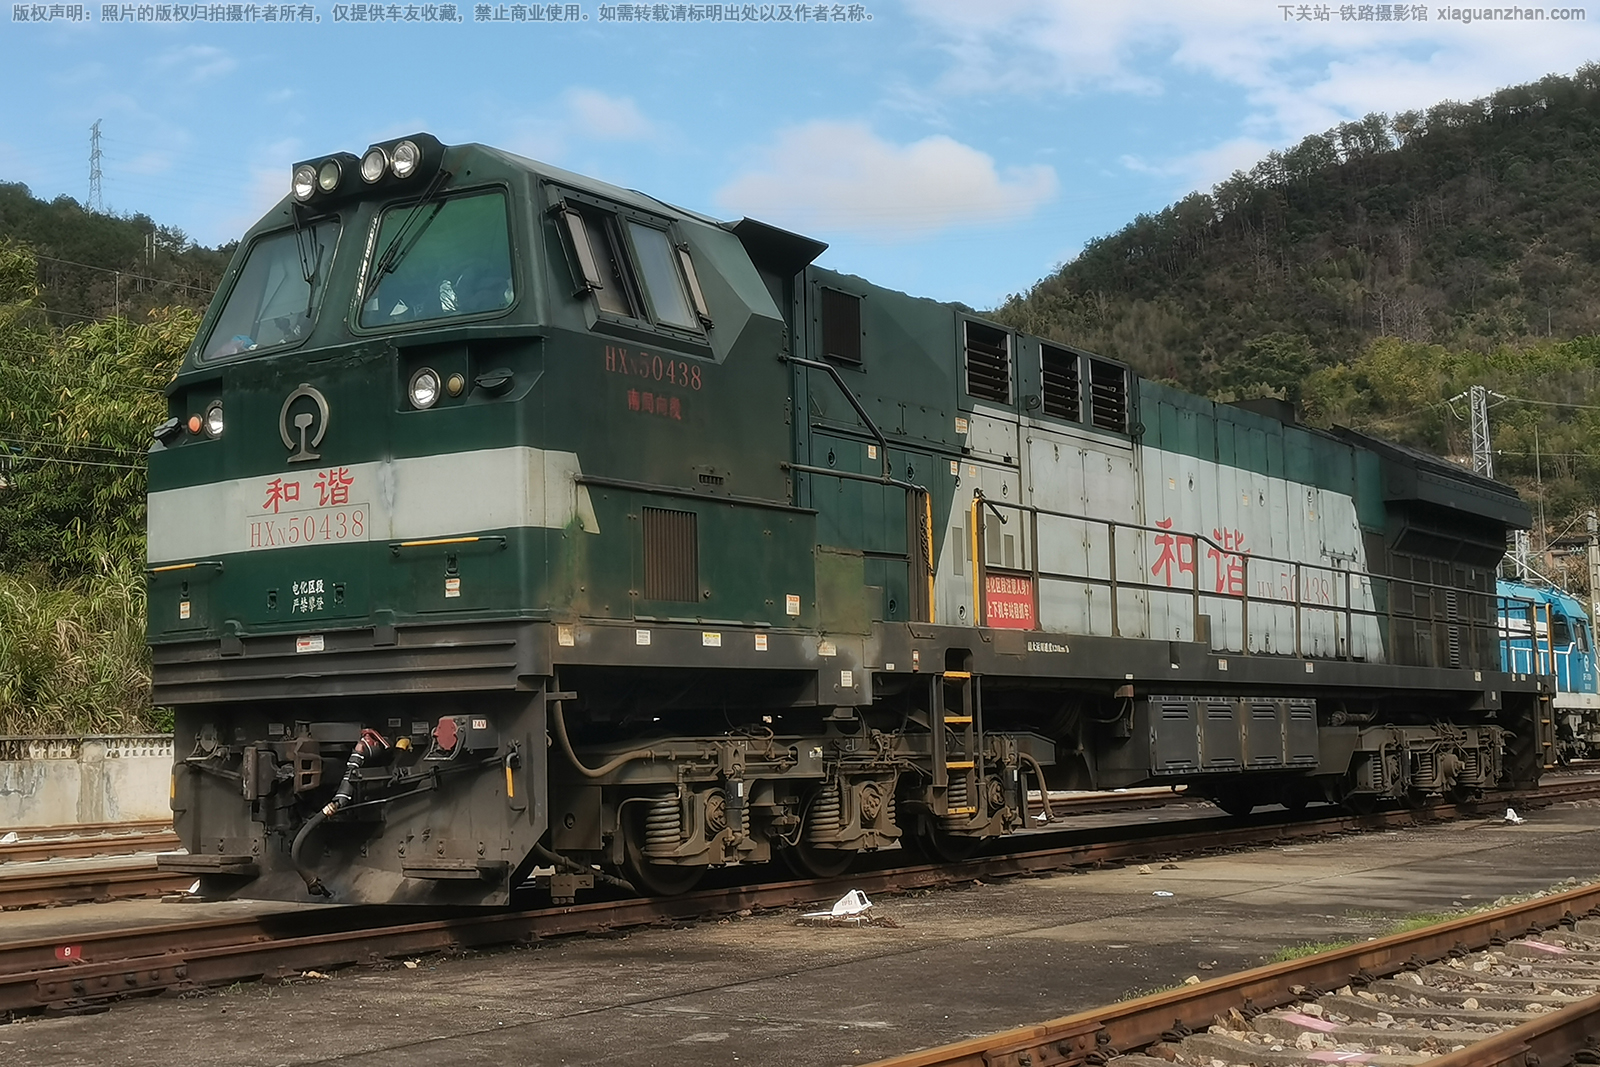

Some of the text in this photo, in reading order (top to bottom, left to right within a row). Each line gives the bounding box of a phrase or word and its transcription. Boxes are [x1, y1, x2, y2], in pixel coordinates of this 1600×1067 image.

[262, 466, 354, 514] 和谐
[250, 510, 364, 548] HXN50438
[1151, 516, 1251, 596] 和谐
[291, 579, 325, 595] 电化区段
